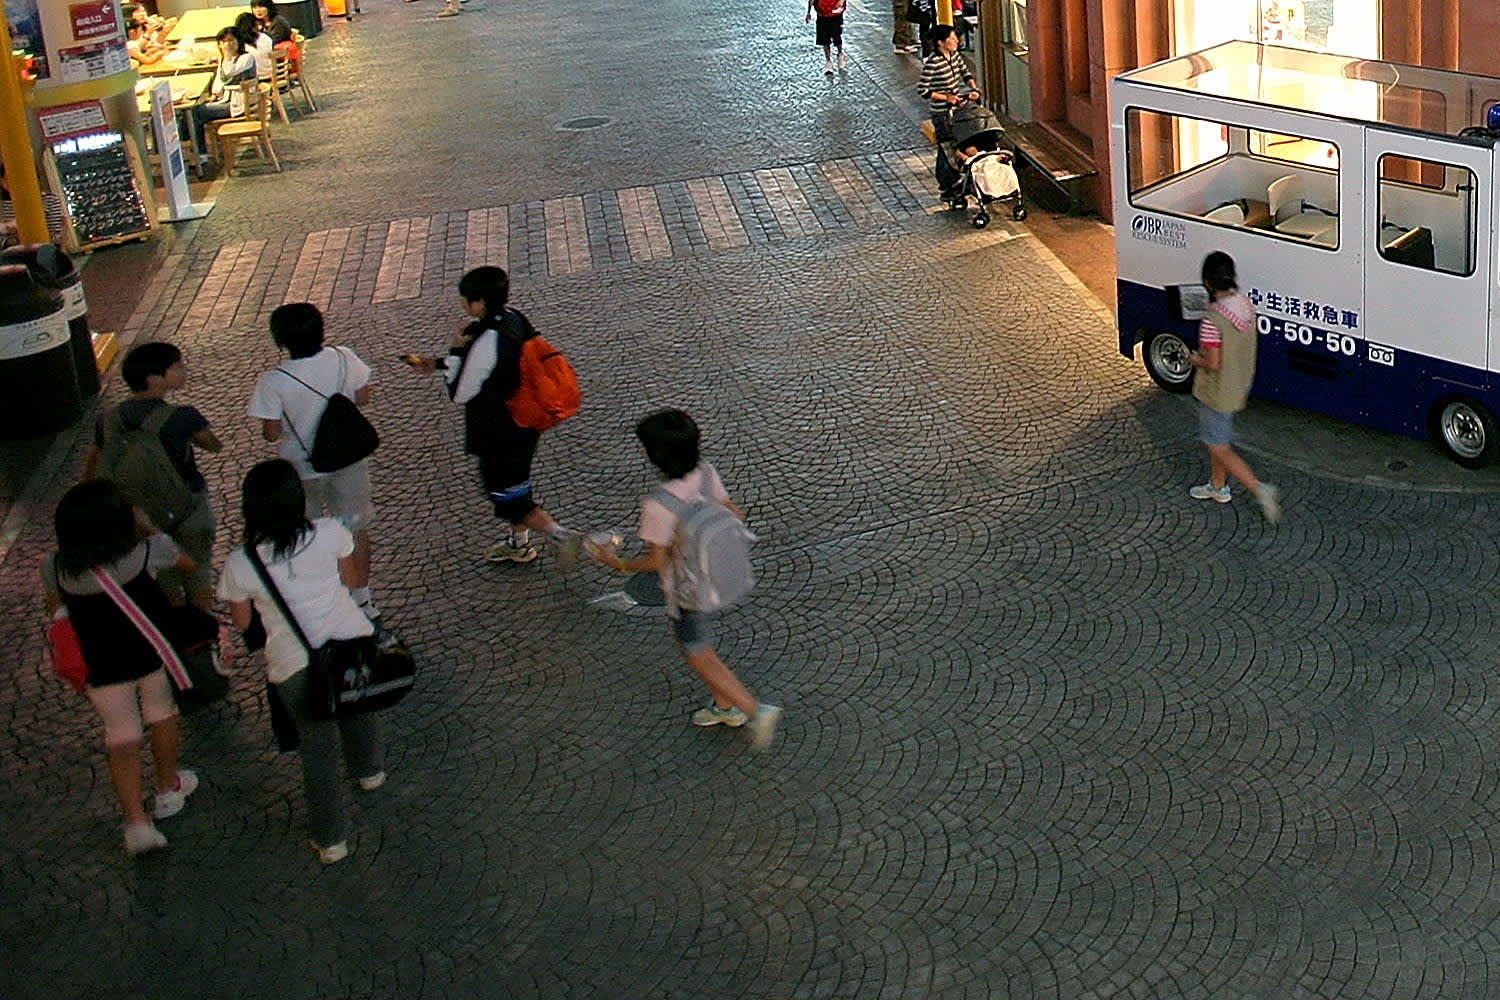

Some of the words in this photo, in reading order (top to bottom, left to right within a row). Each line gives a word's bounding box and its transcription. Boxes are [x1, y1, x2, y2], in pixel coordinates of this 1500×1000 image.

[1144, 216, 1162, 235] JBR
[1266, 292, 1358, 329] 生活救急車
[1257, 315, 1356, 356] 0-50-50
